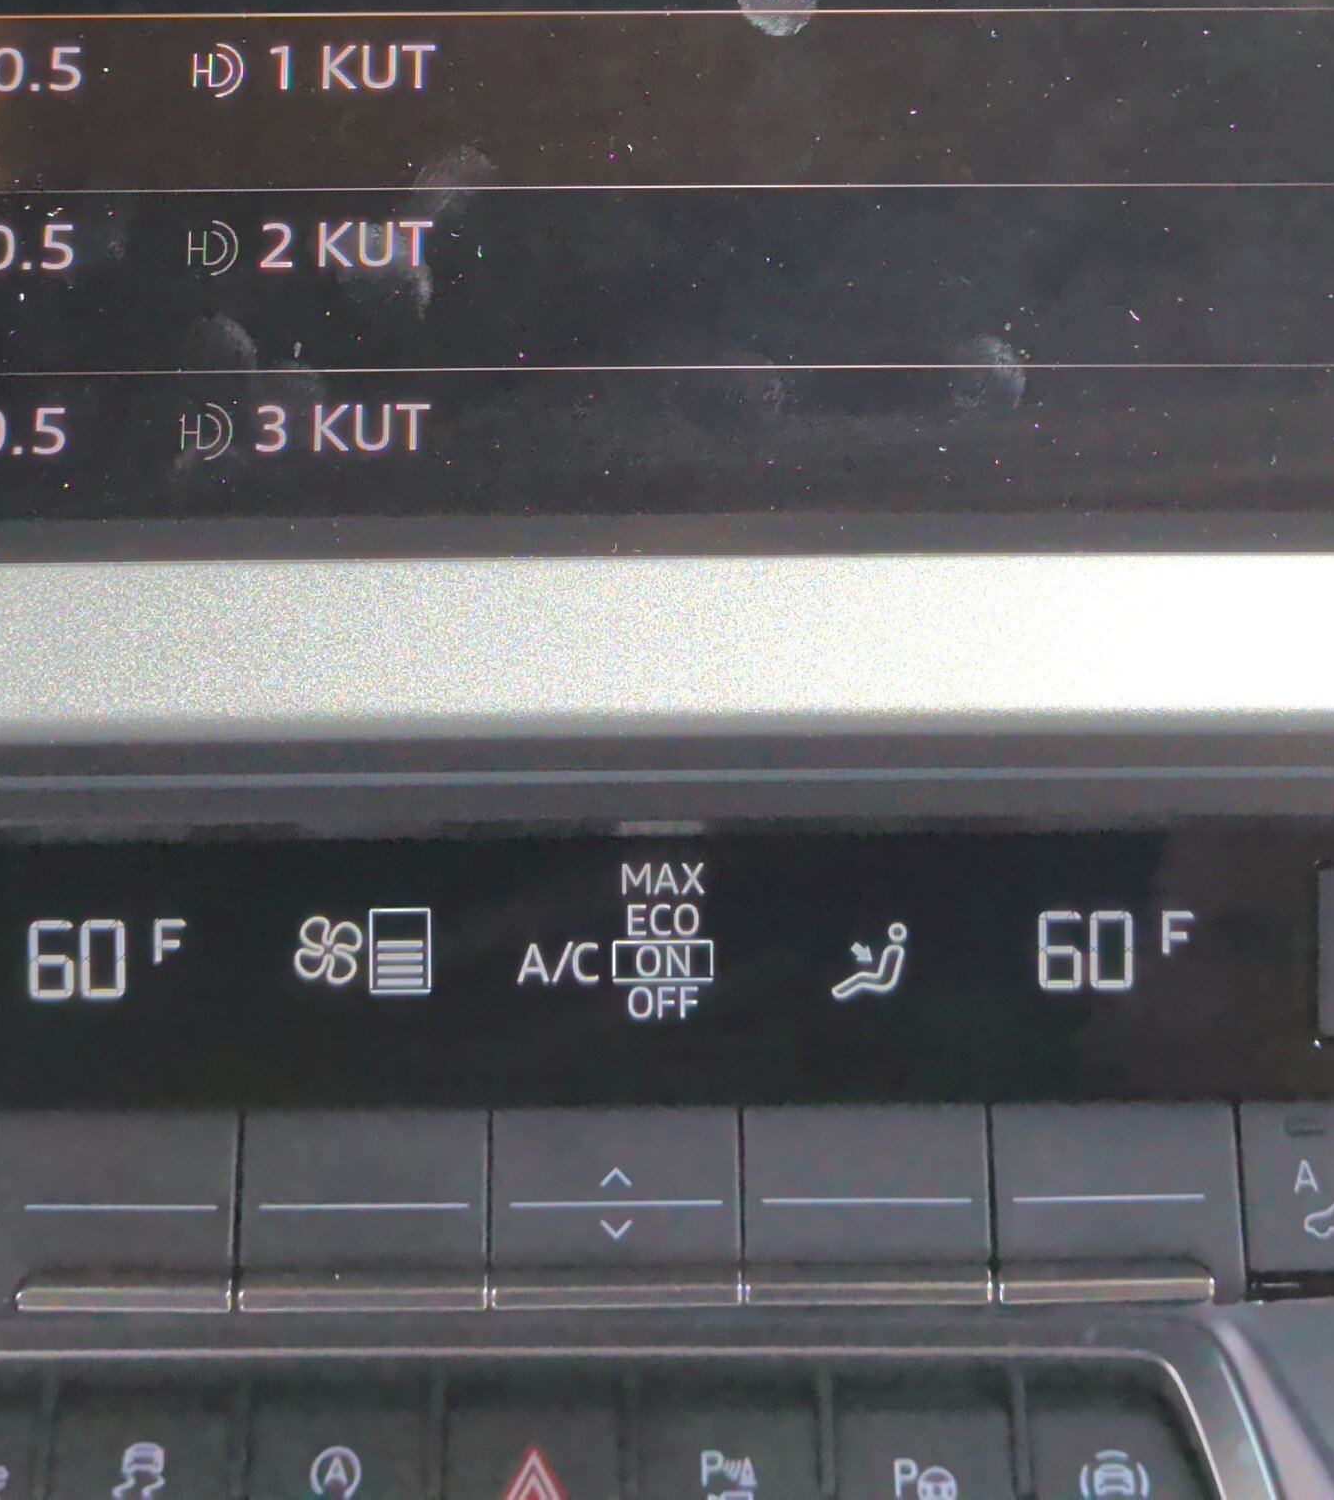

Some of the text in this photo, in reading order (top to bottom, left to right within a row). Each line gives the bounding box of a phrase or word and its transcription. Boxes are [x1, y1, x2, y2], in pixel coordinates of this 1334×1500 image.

[269, 45, 290, 90] 1
[321, 44, 437, 90] KUT
[260, 222, 293, 268] 2
[316, 220, 434, 267] KUT
[254, 405, 288, 452] 3
[312, 403, 432, 451] KUT
[620, 863, 706, 896] MAX
[627, 904, 700, 937] ECO
[27, 918, 188, 1000] 60 F
[517, 941, 692, 986] A/C ON
[1037, 910, 1195, 991] 60 F
[627, 986, 699, 1021] OFF
[1293, 1159, 1320, 1194] A
